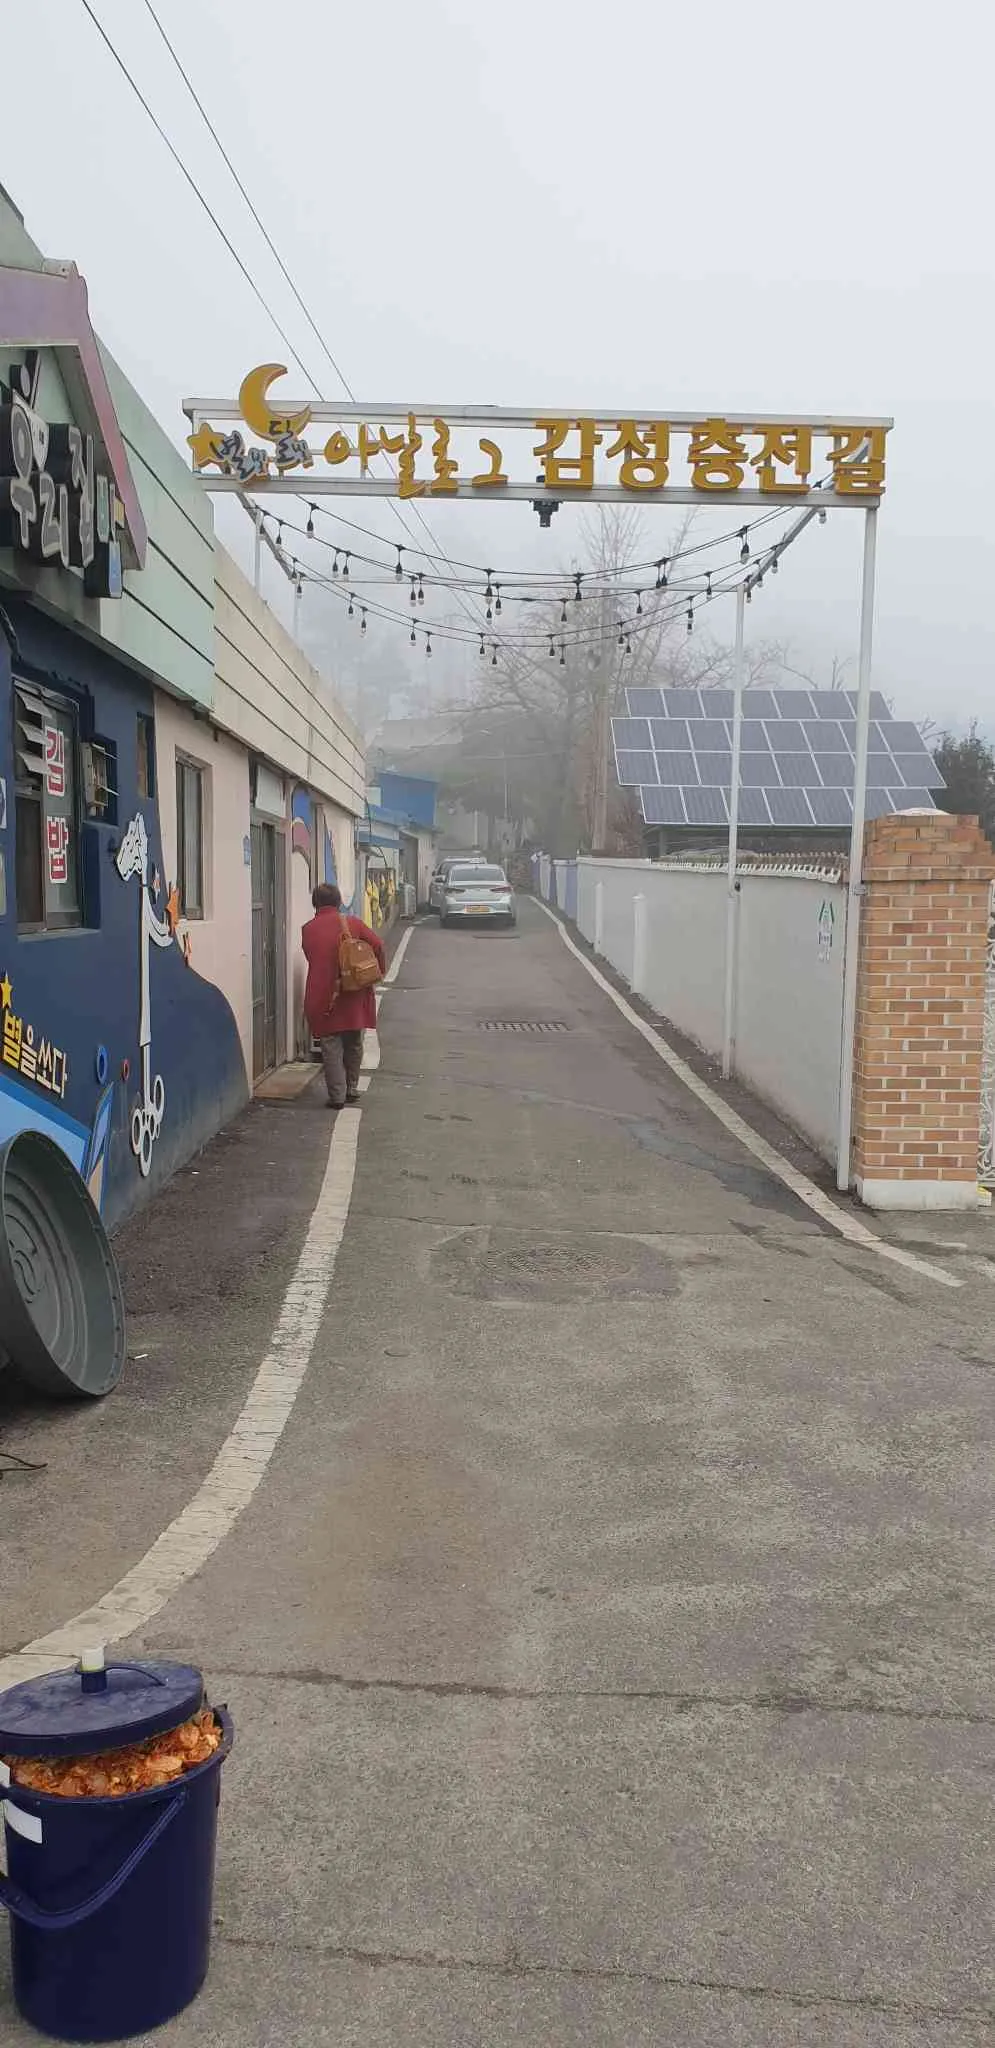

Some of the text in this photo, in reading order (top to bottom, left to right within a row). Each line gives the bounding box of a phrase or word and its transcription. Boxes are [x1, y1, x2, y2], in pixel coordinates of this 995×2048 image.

[10, 402, 96, 570] 우리집
[324, 411, 509, 499] 아날로그
[46, 727, 69, 884] 김밥
